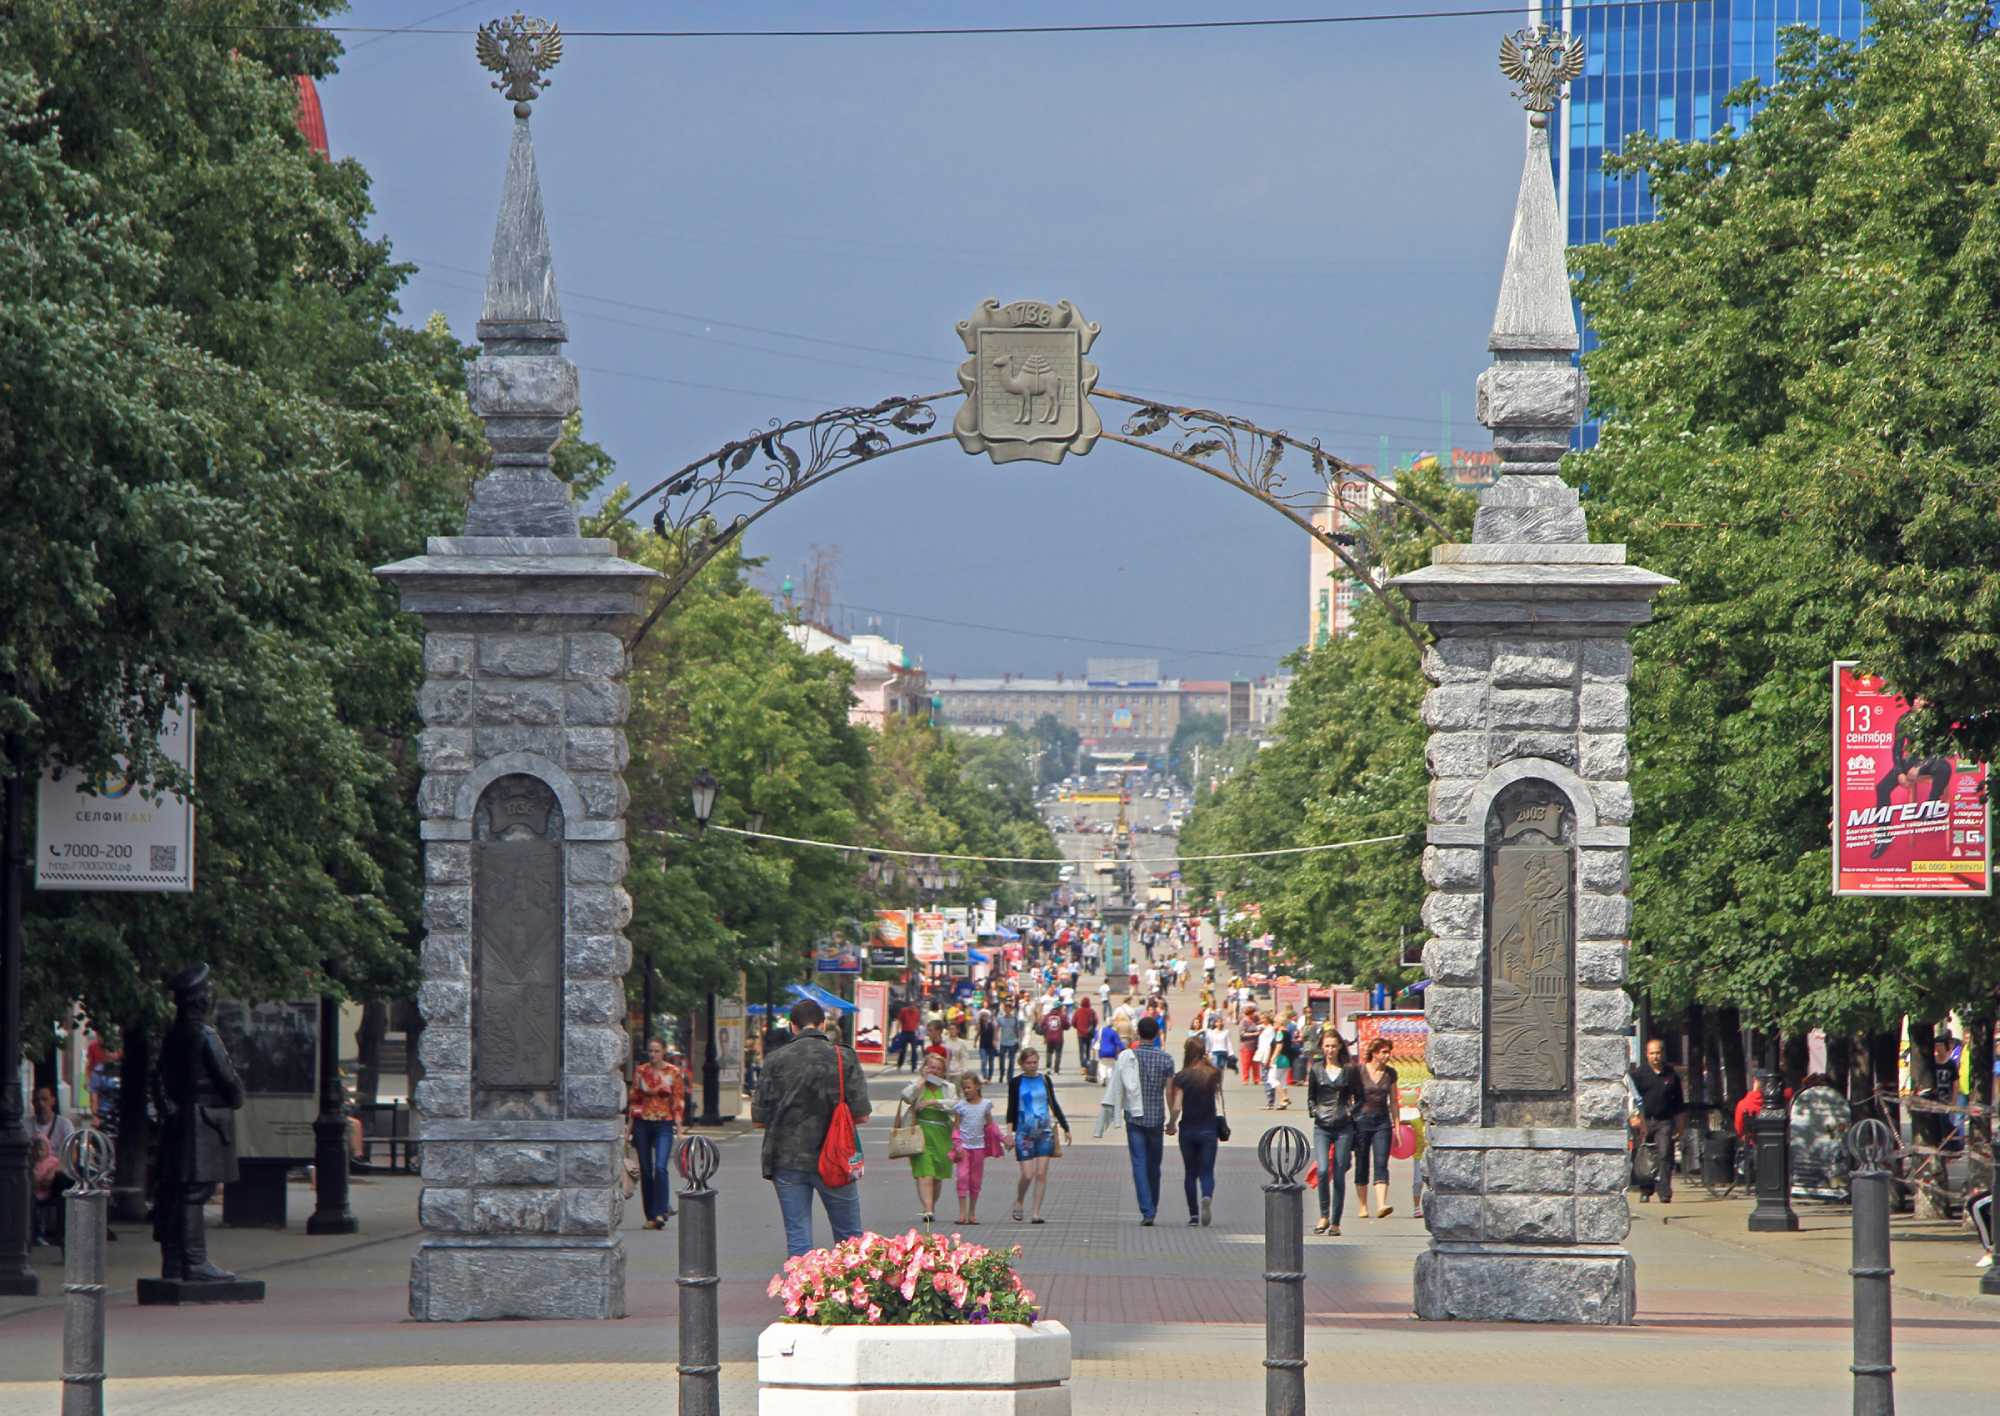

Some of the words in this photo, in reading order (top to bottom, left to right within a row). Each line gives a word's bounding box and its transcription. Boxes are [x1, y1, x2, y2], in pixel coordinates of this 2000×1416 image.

[1007, 304, 1051, 325] 1736
[1846, 704, 1871, 732] 13
[1846, 730, 1892, 745] сентября
[1847, 800, 1950, 827] МИГЕЛЬ
[64, 844, 133, 858] 7000-200
